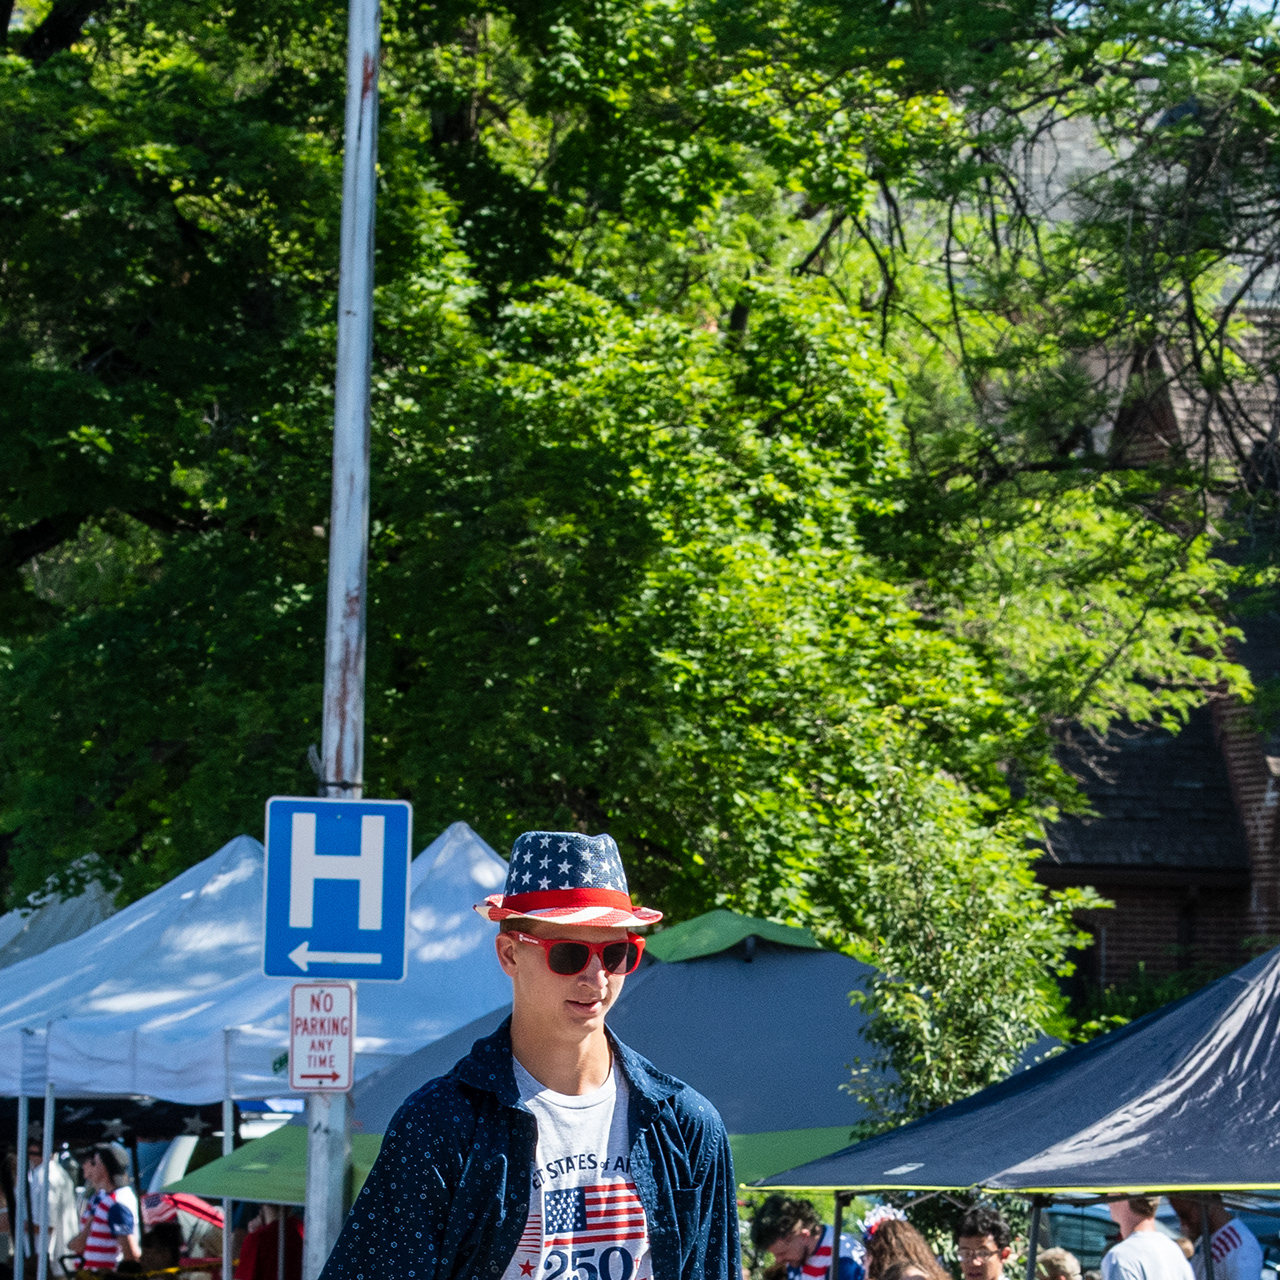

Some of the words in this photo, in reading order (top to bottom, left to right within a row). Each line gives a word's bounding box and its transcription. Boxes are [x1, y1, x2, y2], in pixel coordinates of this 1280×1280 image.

[289, 812, 385, 930] H
[310, 992, 333, 1013] NO
[295, 1017, 348, 1036] PARKING
[310, 1040, 332, 1051] ANY
[307, 1055, 334, 1068] TIME
[546, 1153, 598, 1179] STATES
[600, 1158, 610, 1170] of
